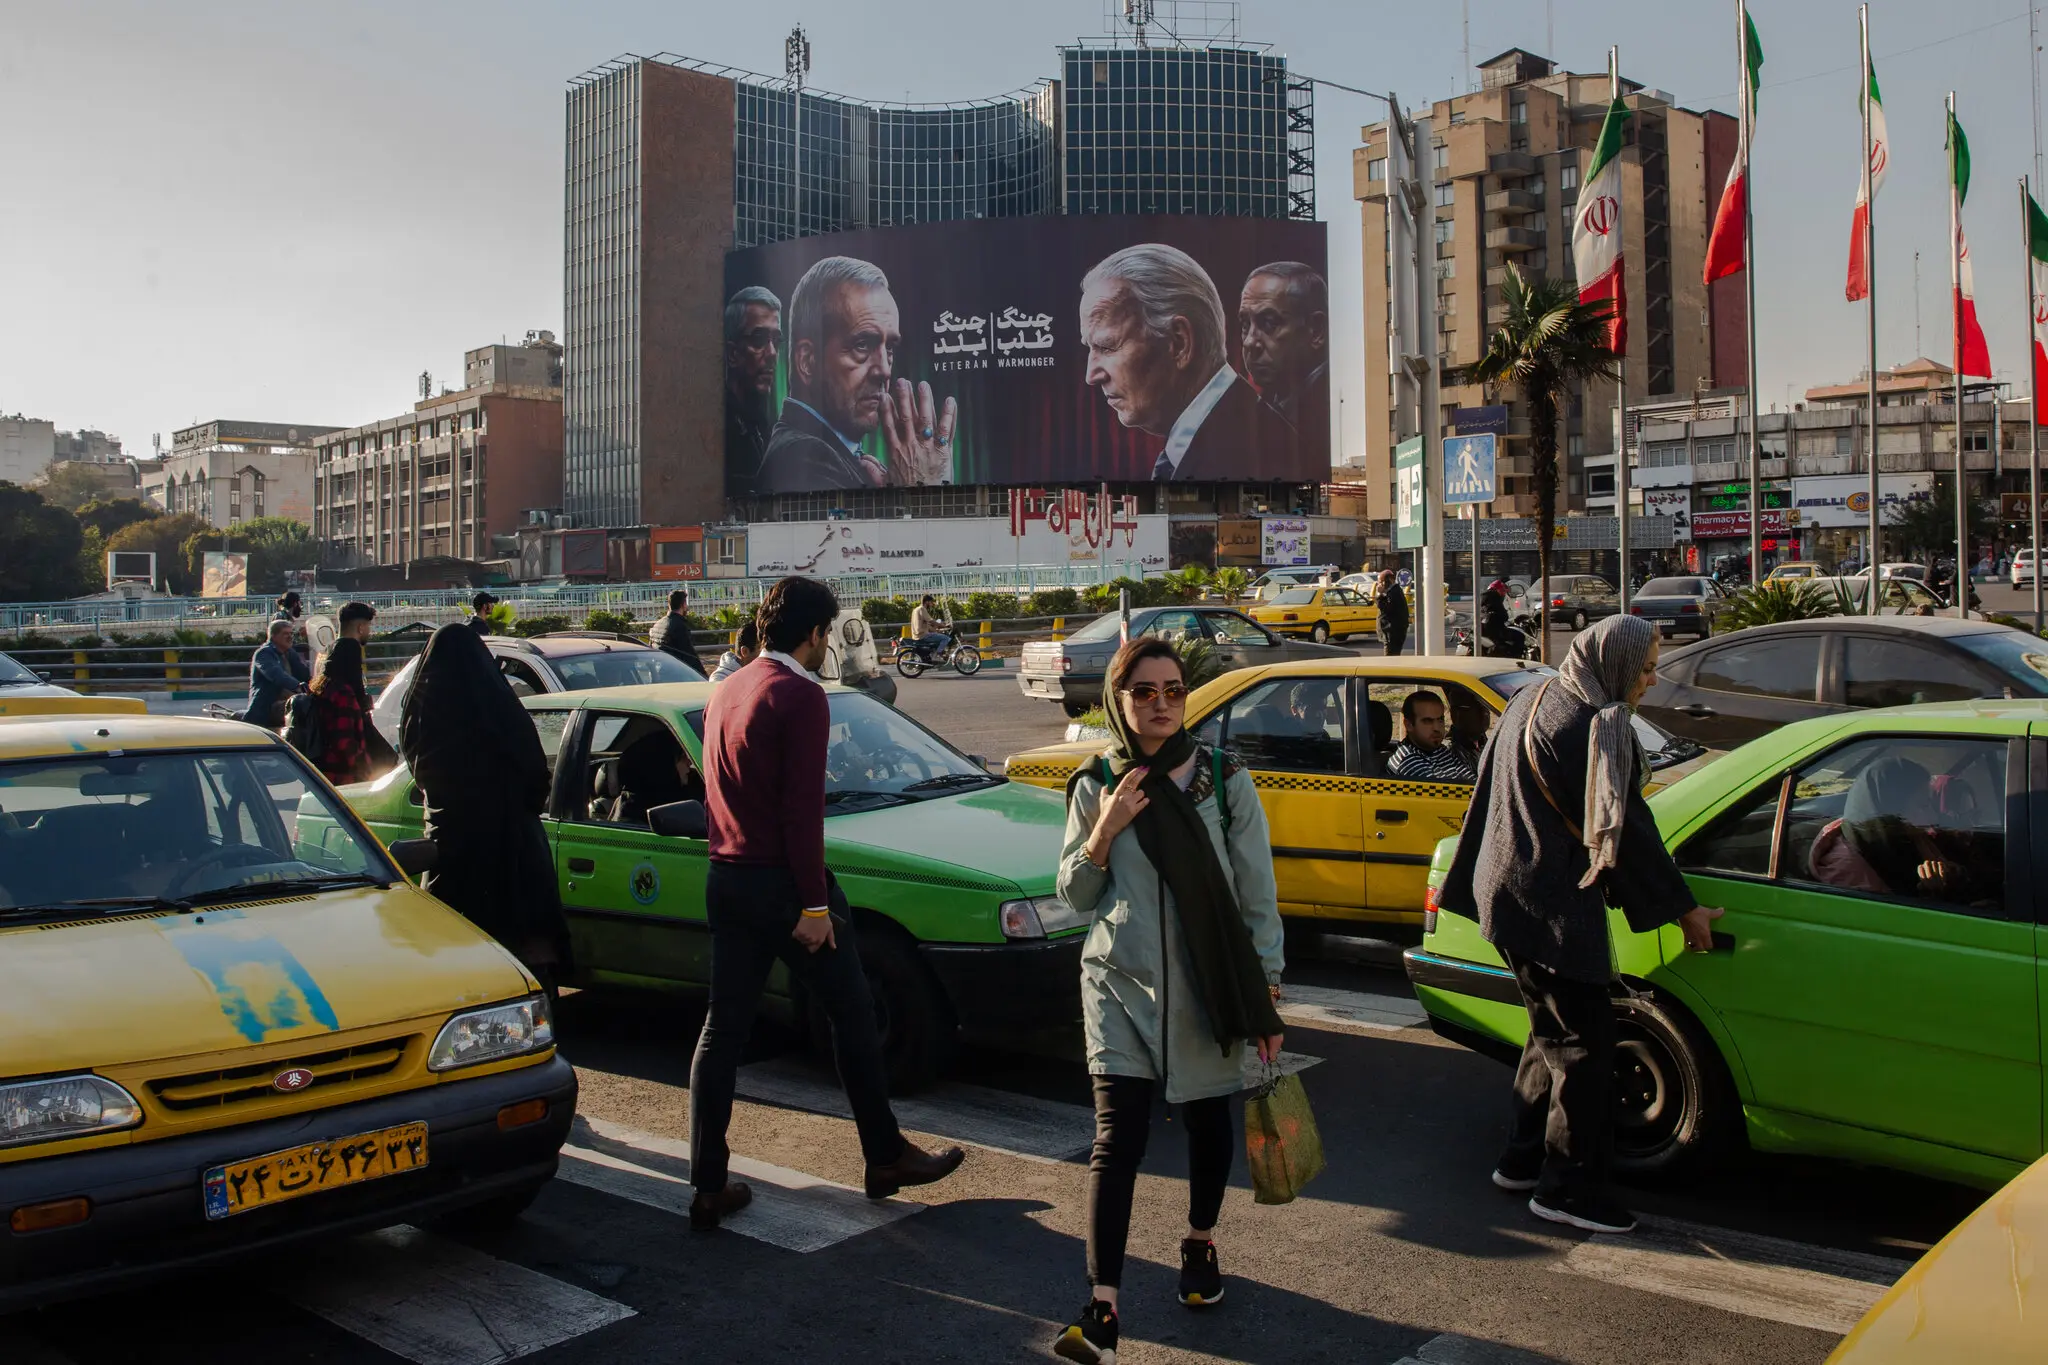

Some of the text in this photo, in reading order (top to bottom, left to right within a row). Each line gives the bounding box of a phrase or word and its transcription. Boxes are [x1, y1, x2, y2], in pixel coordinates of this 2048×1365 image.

[934, 310, 986, 334] جنگ
[998, 306, 1053, 331] جنگ
[934, 333, 987, 356] بلد
[997, 329, 1054, 355] طلب
[934, 357, 1054, 371] VETERAN WARMONGER
[1693, 516, 1736, 525] Pharmacy
